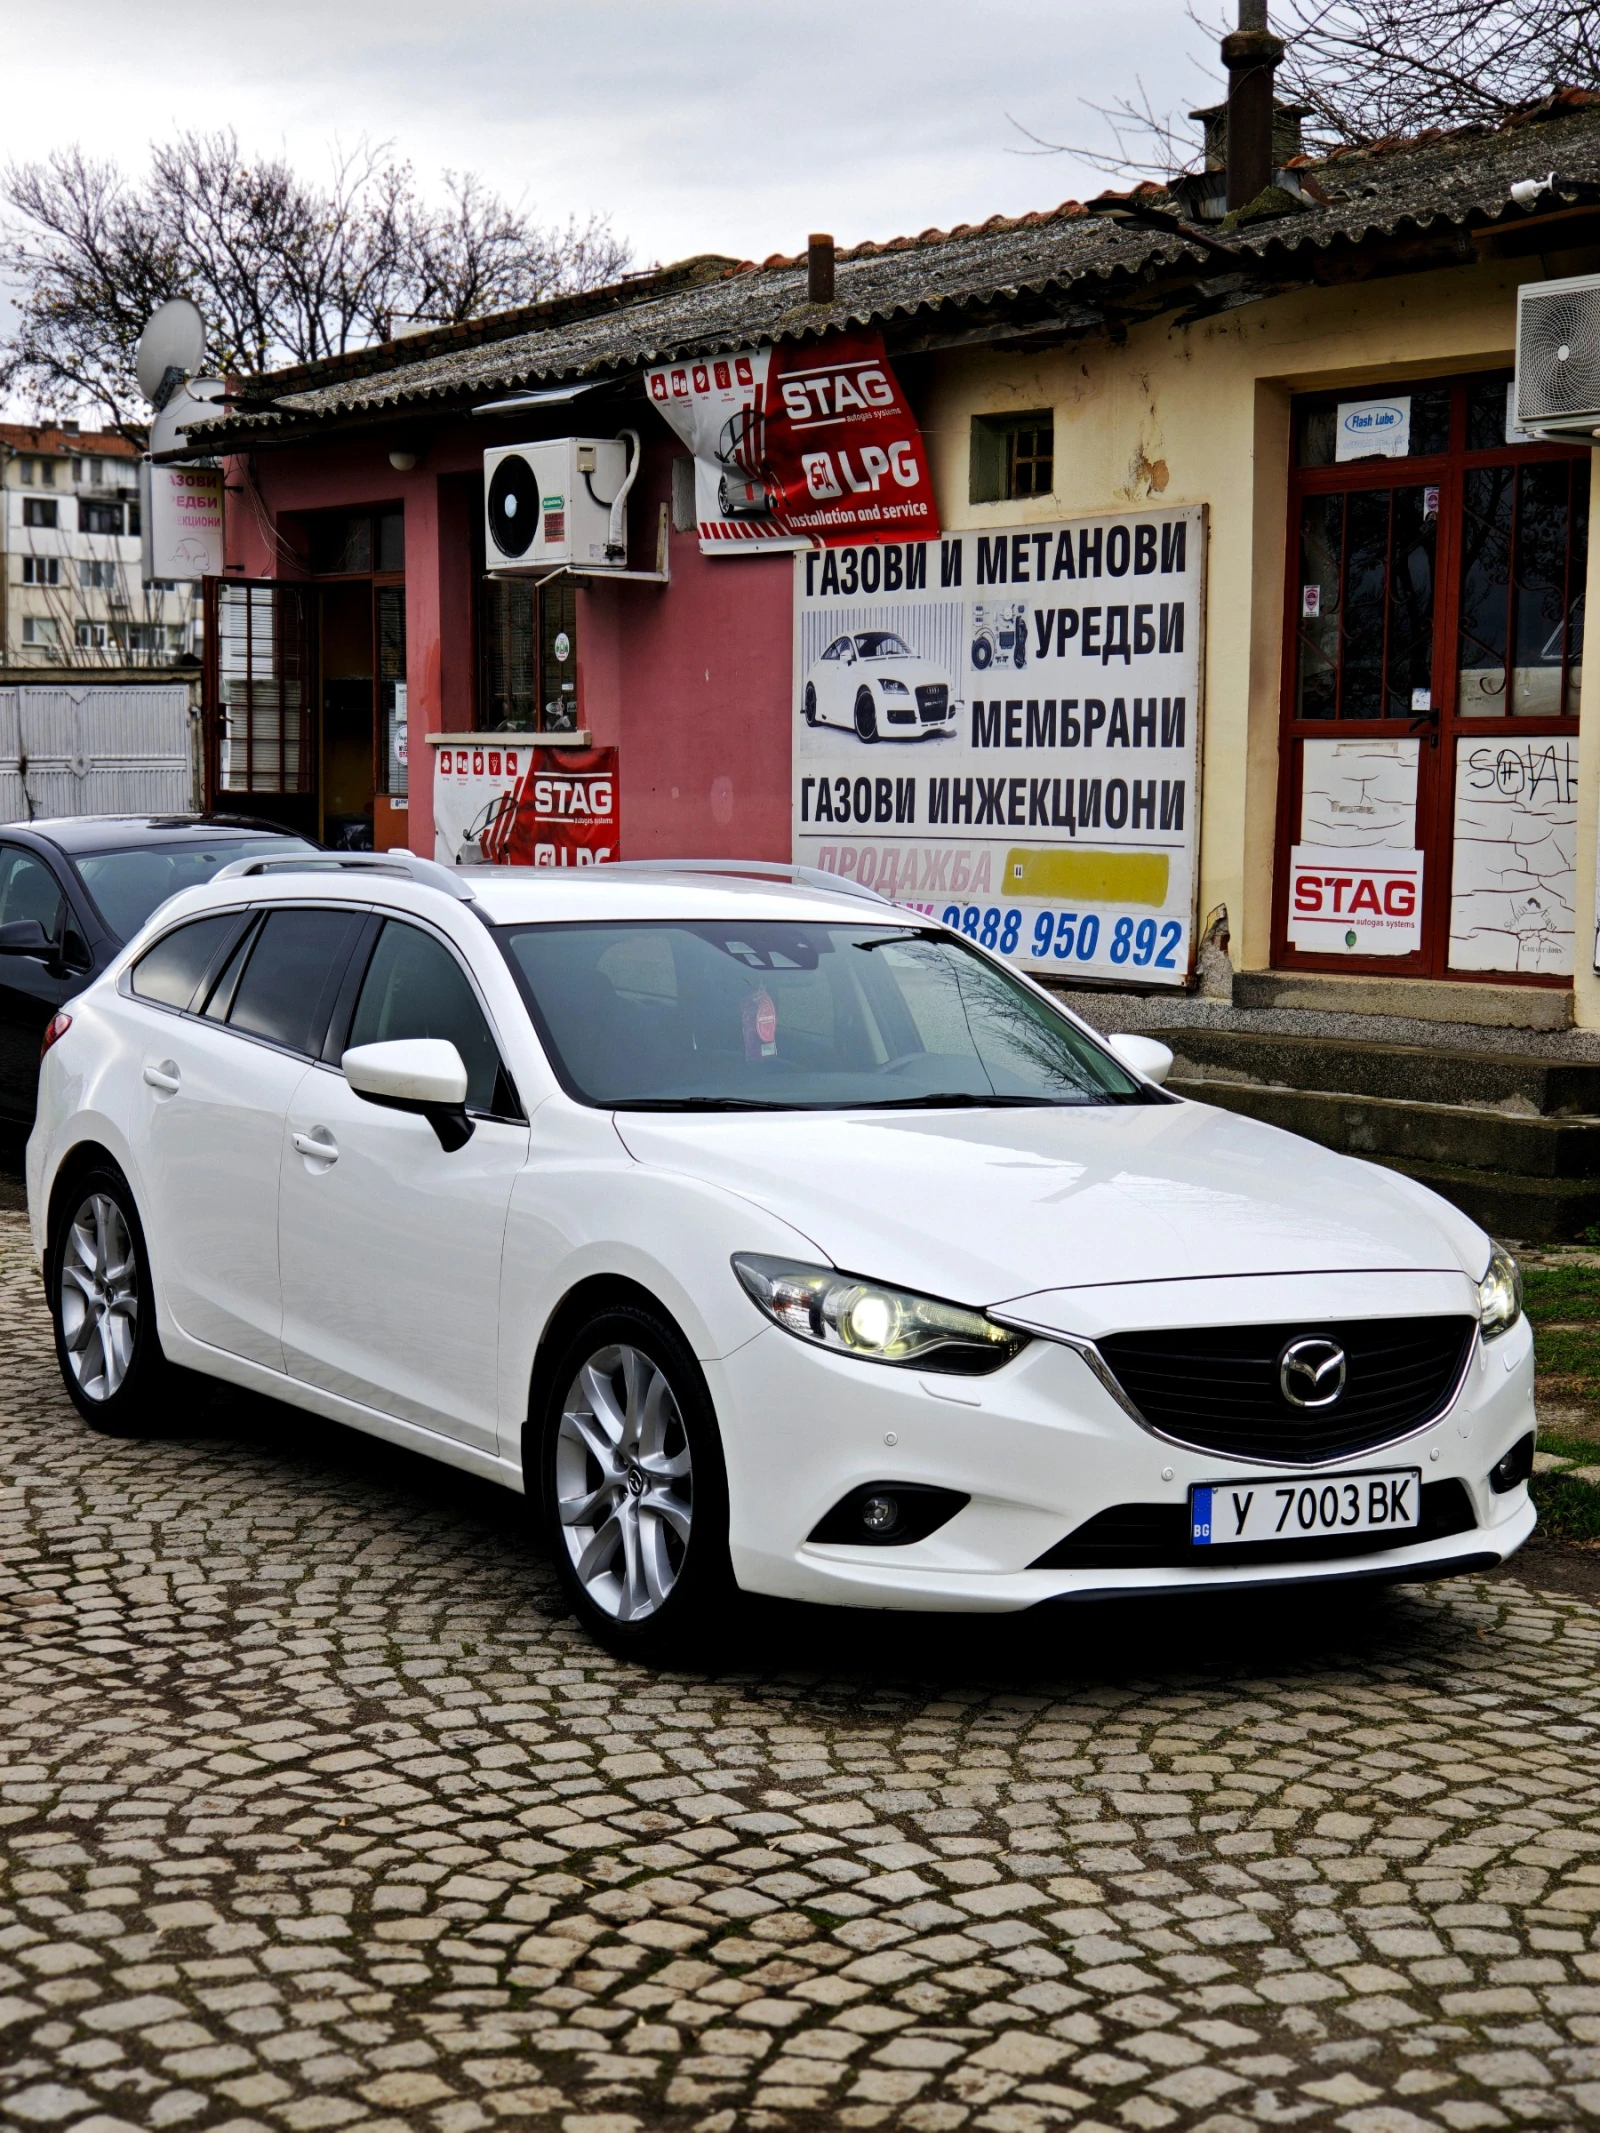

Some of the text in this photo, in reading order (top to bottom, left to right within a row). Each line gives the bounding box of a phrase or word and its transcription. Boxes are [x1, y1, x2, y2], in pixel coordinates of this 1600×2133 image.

[781, 370, 895, 420] STAG
[846, 407, 902, 423] autogas systems
[1352, 412, 1395, 428] Flash Lube
[837, 440, 920, 493] LPG
[785, 500, 928, 528] Installation and service
[805, 521, 1188, 597] ГАЗОВИ И МЕТАНОВИ
[1034, 601, 1186, 666] УРЕДБИ
[971, 697, 1187, 749] МЕМБРАНИ
[534, 780, 612, 815] STAG
[801, 777, 1186, 837] ГАЗОВИ ИНЖЕКЦИОНИ
[817, 846, 992, 897] ПРОДАЖБА
[1294, 875, 1416, 917] STAG
[1031, 910, 1100, 962] 950
[1109, 916, 1183, 969] 892
[1356, 917, 1415, 930] autogas systems
[1193, 1524, 1210, 1538] BG
